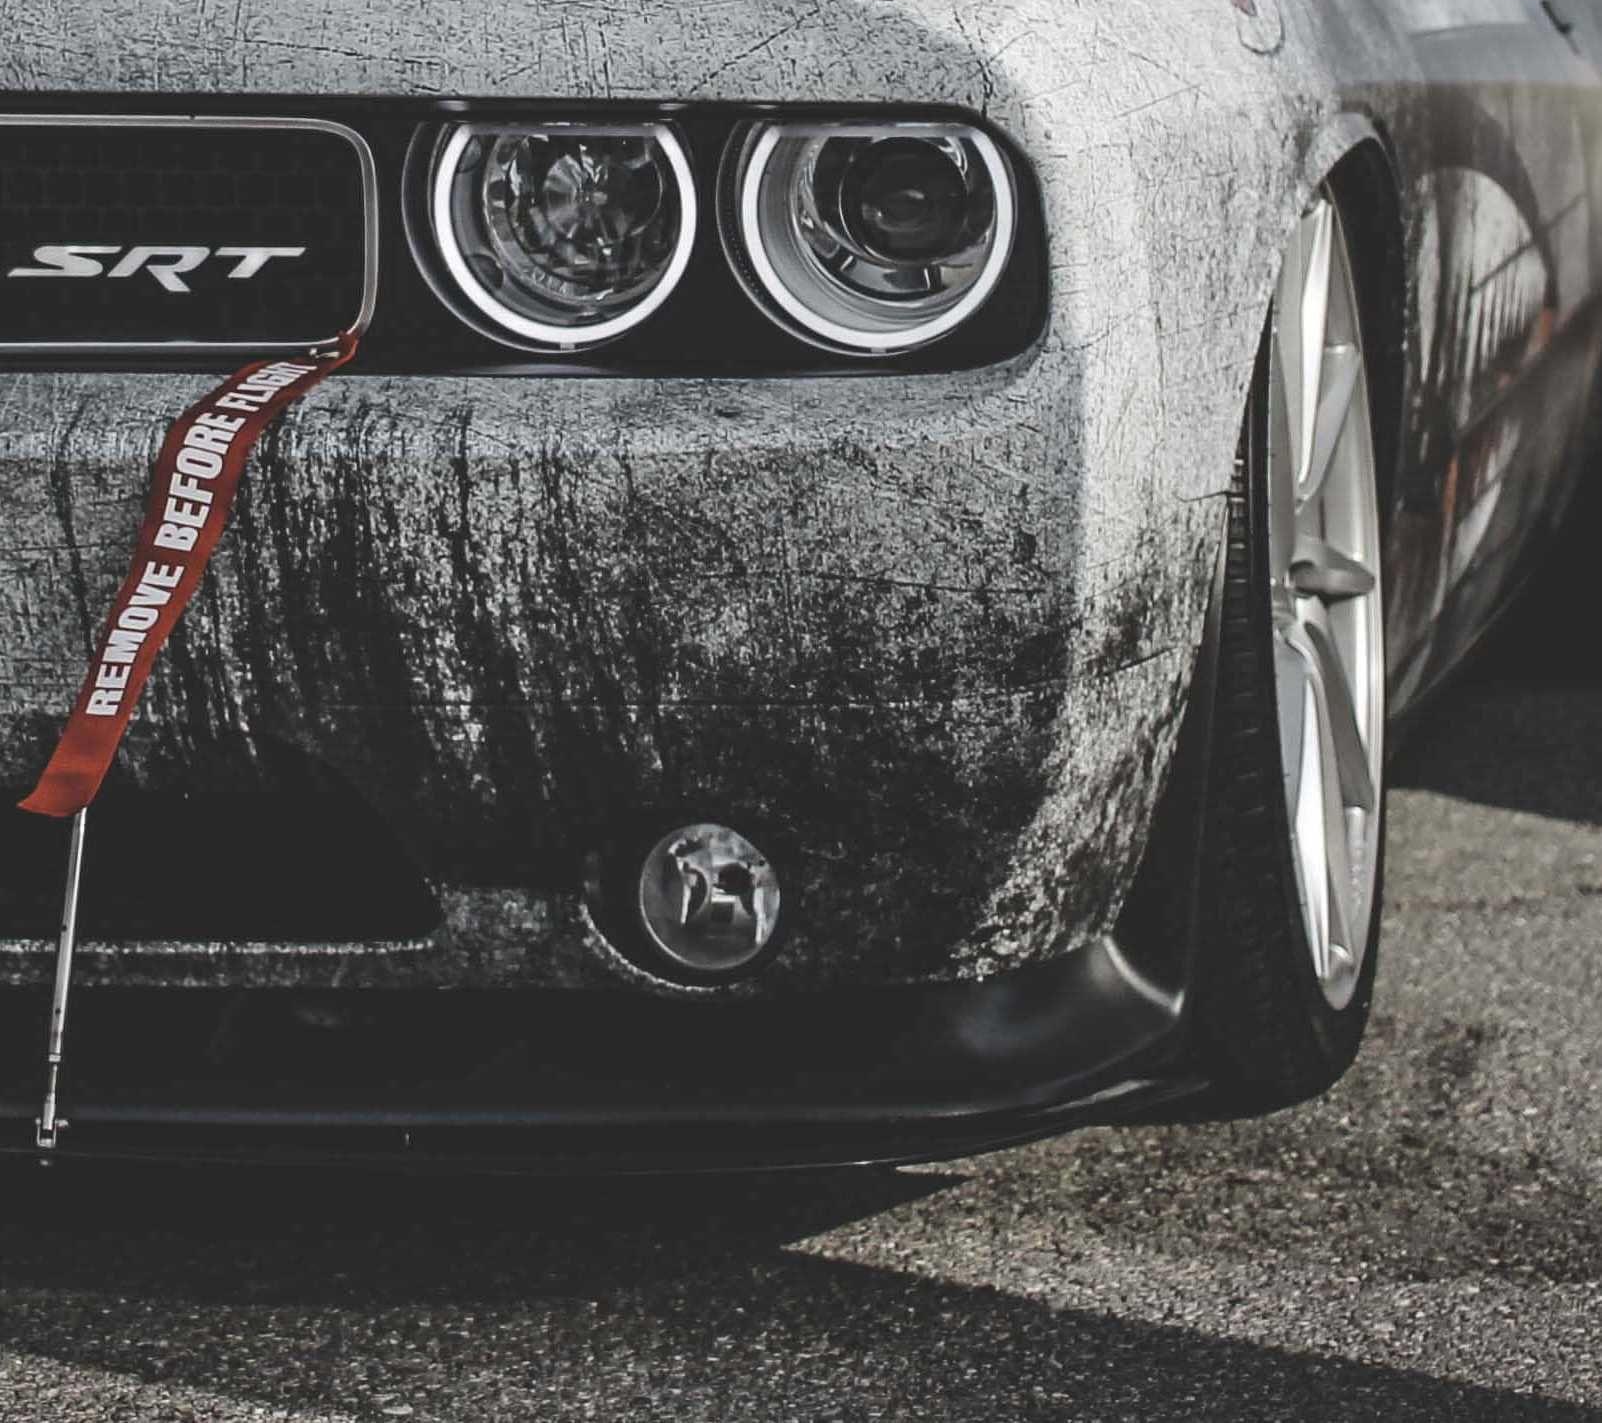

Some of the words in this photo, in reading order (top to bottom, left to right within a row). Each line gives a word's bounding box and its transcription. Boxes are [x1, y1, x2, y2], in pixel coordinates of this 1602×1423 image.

[8, 245, 306, 292] SRT
[86, 561, 184, 716] REMOVE
[154, 412, 246, 552] BEFORE
[216, 361, 318, 413] FLIGHT
